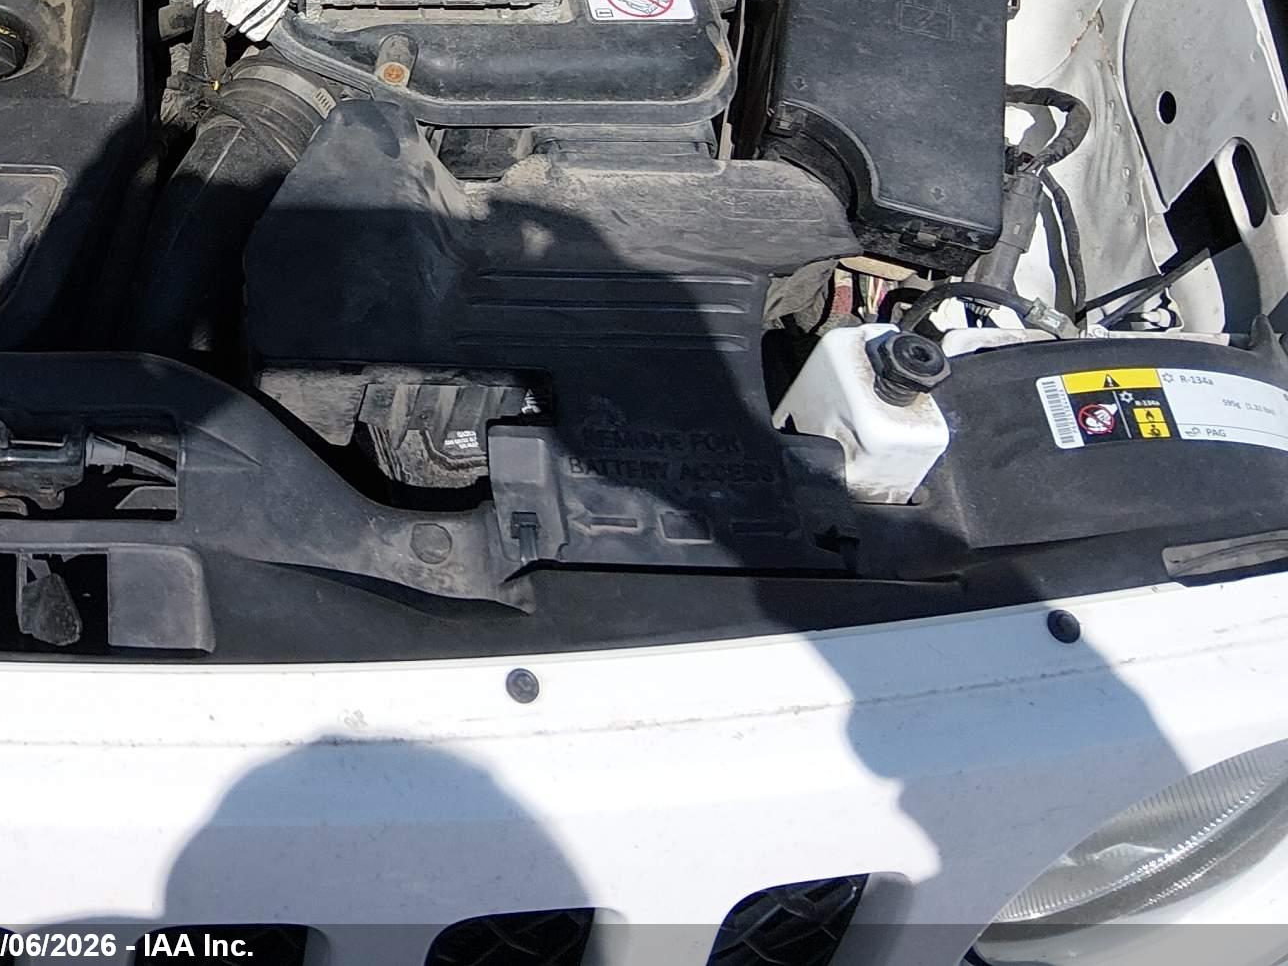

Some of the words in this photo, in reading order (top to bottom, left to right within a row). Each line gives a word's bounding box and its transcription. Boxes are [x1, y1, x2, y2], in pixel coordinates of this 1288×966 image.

[1179, 374, 1215, 386] R-134a
[1206, 427, 1228, 438] PAG
[568, 457, 670, 481] BATTERY
